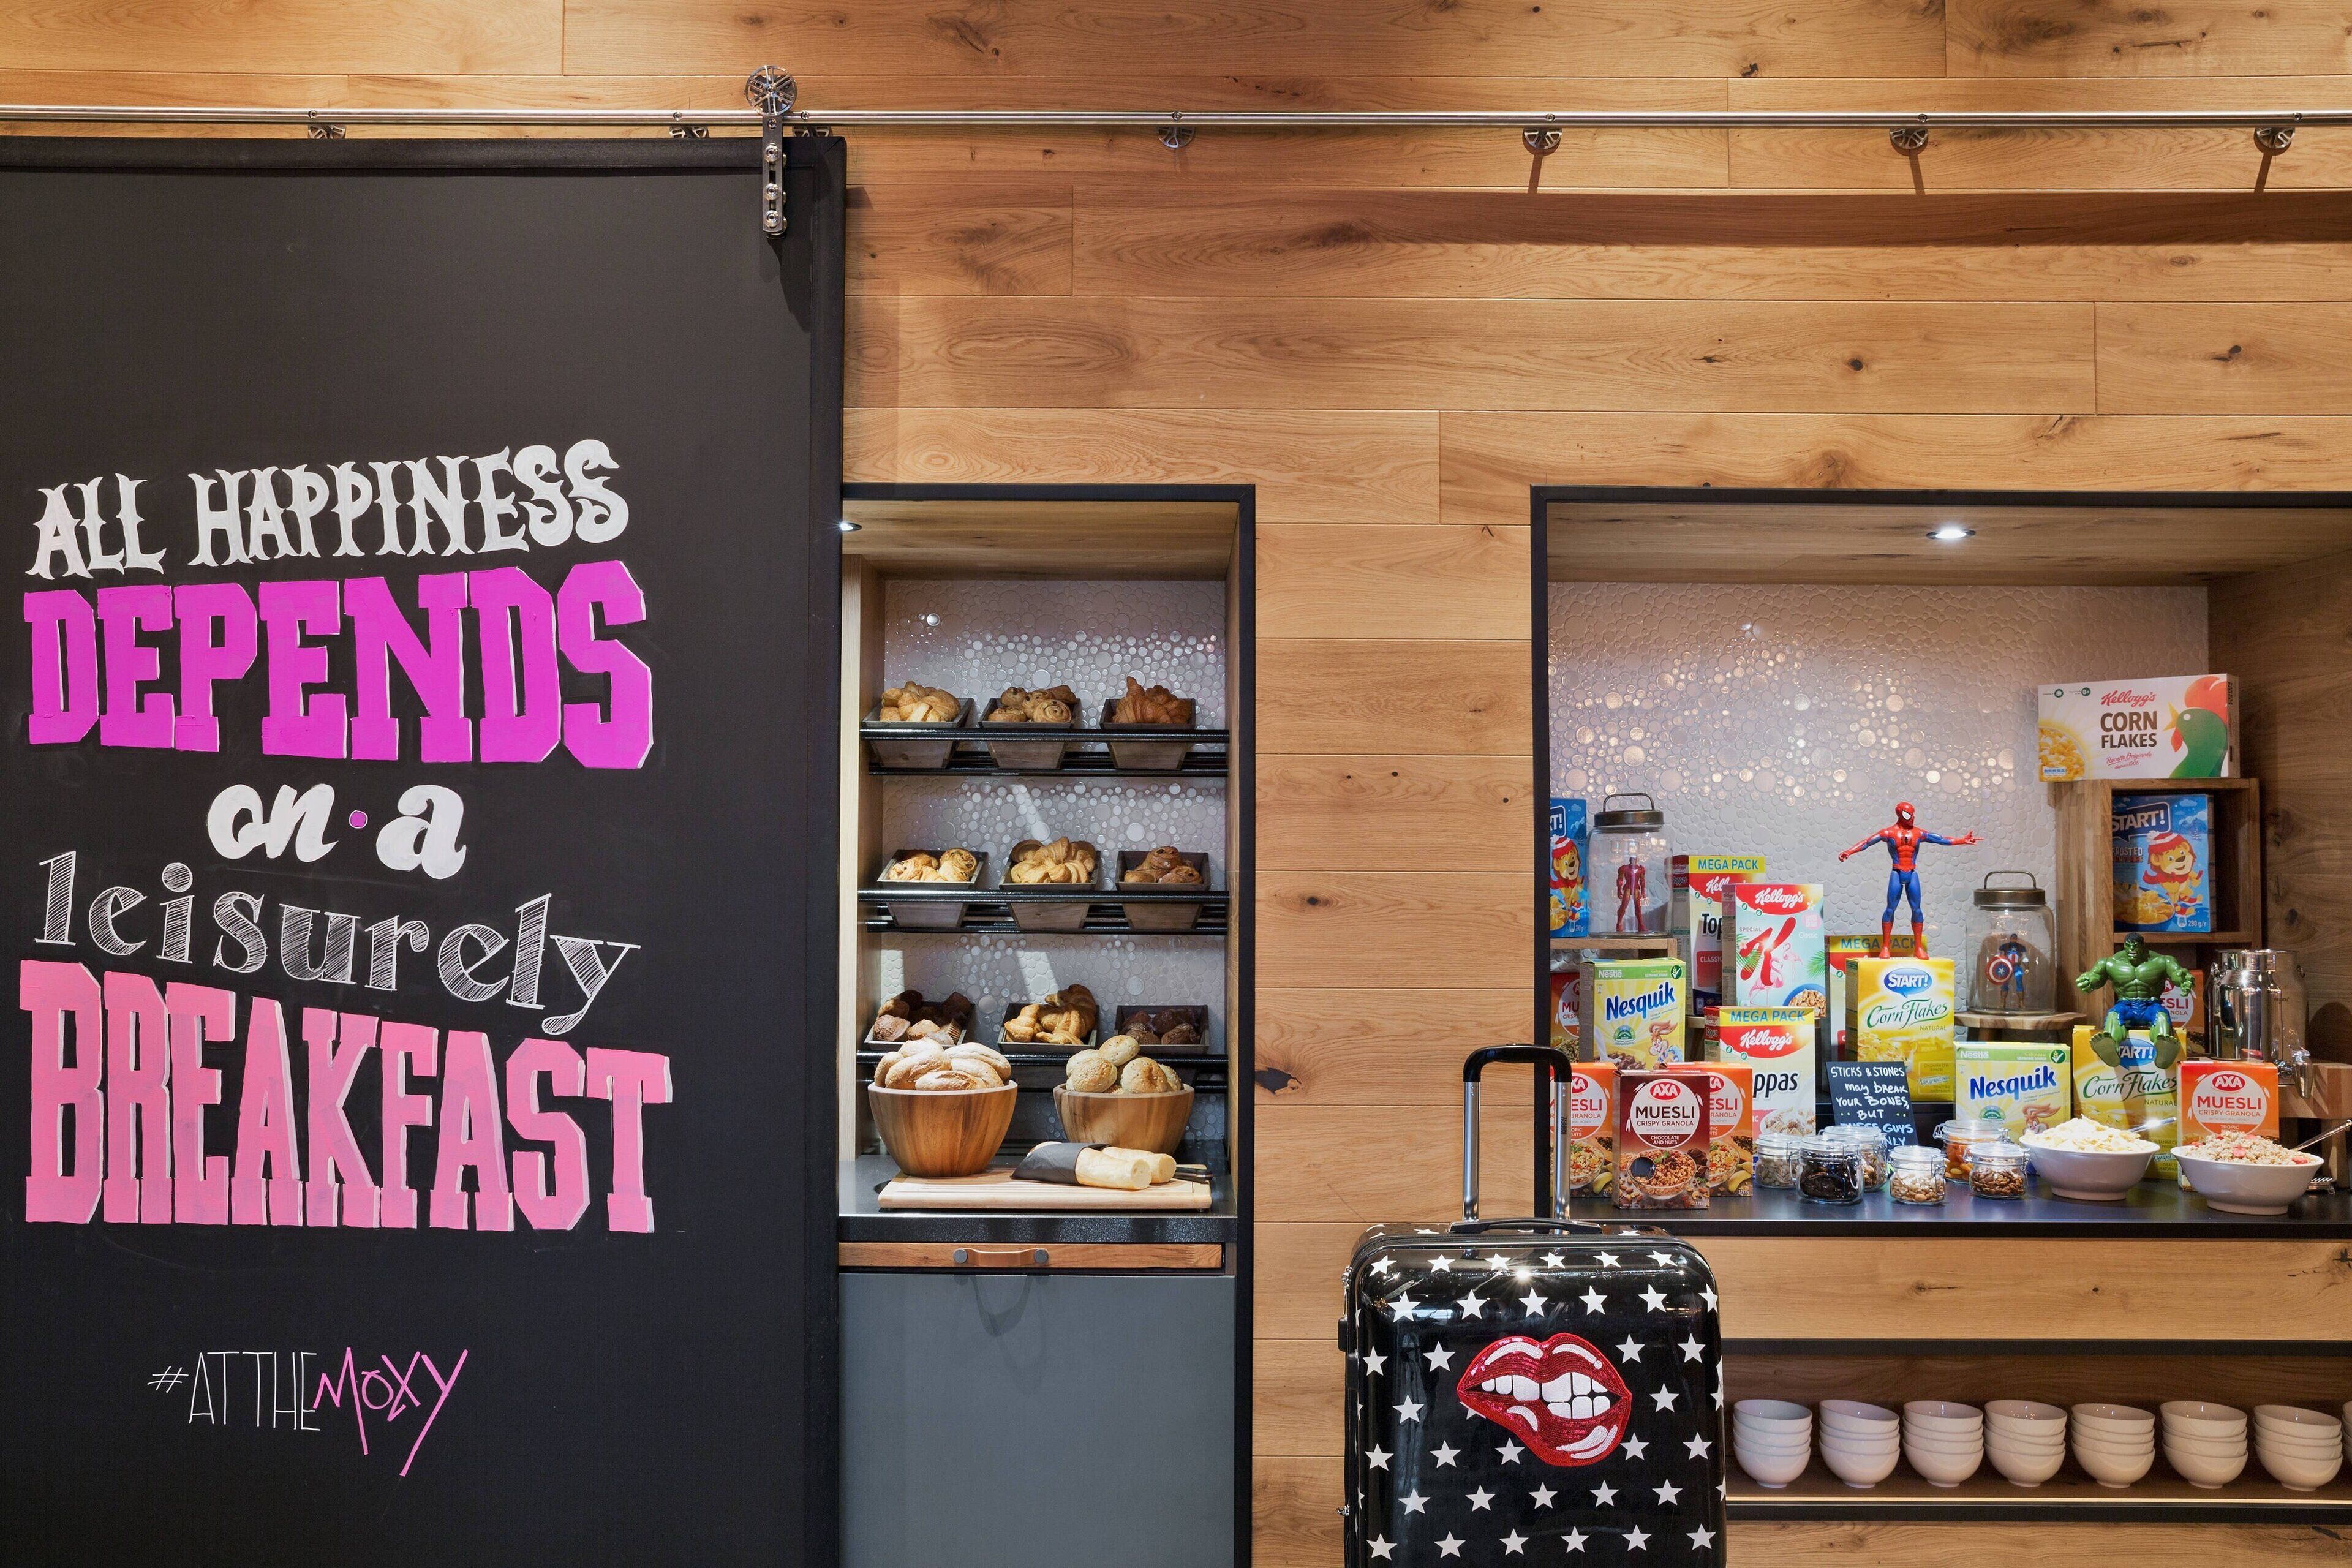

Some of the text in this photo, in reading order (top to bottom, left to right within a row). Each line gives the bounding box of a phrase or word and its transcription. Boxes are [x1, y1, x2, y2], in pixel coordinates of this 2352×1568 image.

[26, 439, 629, 579] ALL HAPPINESS
[24, 560, 654, 769] DEPENDS
[2101, 689, 2156, 707] Kellogg's
[2100, 710, 2157, 732] CORN
[2101, 733, 2157, 748] FLAKES
[1698, 859, 1729, 870] MEGA
[1732, 859, 1758, 870] PACK
[1706, 876, 1730, 894] Kell
[1755, 888, 1805, 908] Kellogg's
[34, 851, 641, 1035] leisurely
[1841, 938, 1915, 949] MEGA ACK
[1888, 974, 1928, 987] START!
[1606, 982, 1675, 1020] Nesquik
[1730, 1011, 1768, 1022] MEGA
[1772, 1010, 1805, 1022] PACK
[1867, 999, 1948, 1030] Corn Flakes
[1740, 1029, 1793, 1051] Kellogg's
[2118, 1047, 2154, 1059] TART!
[1831, 1067, 1862, 1078] STICKS
[1572, 1079, 1587, 1090] XA
[1753, 1072, 1798, 1098] ppas
[1970, 1065, 2057, 1100] Nesquik
[2083, 1076, 2124, 1099] Corn
[2121, 1071, 2177, 1101] Flakes
[2215, 1076, 2242, 1088] AXA
[1653, 1084, 1678, 1096] AXA
[1845, 1083, 1869, 1096] may
[20, 960, 672, 1233] BREAKFAST
[1836, 1097, 1862, 1107] YOUR
[2197, 1096, 2261, 1110] MUESLI
[1572, 1099, 1602, 1111] ESLI
[1709, 1098, 1738, 1110] ESLI
[1635, 1106, 1694, 1118] MUESLI
[1857, 1109, 1884, 1120] BUT
[1882, 1123, 1914, 1134] GUYS
[1882, 1136, 1906, 1146] NLY
